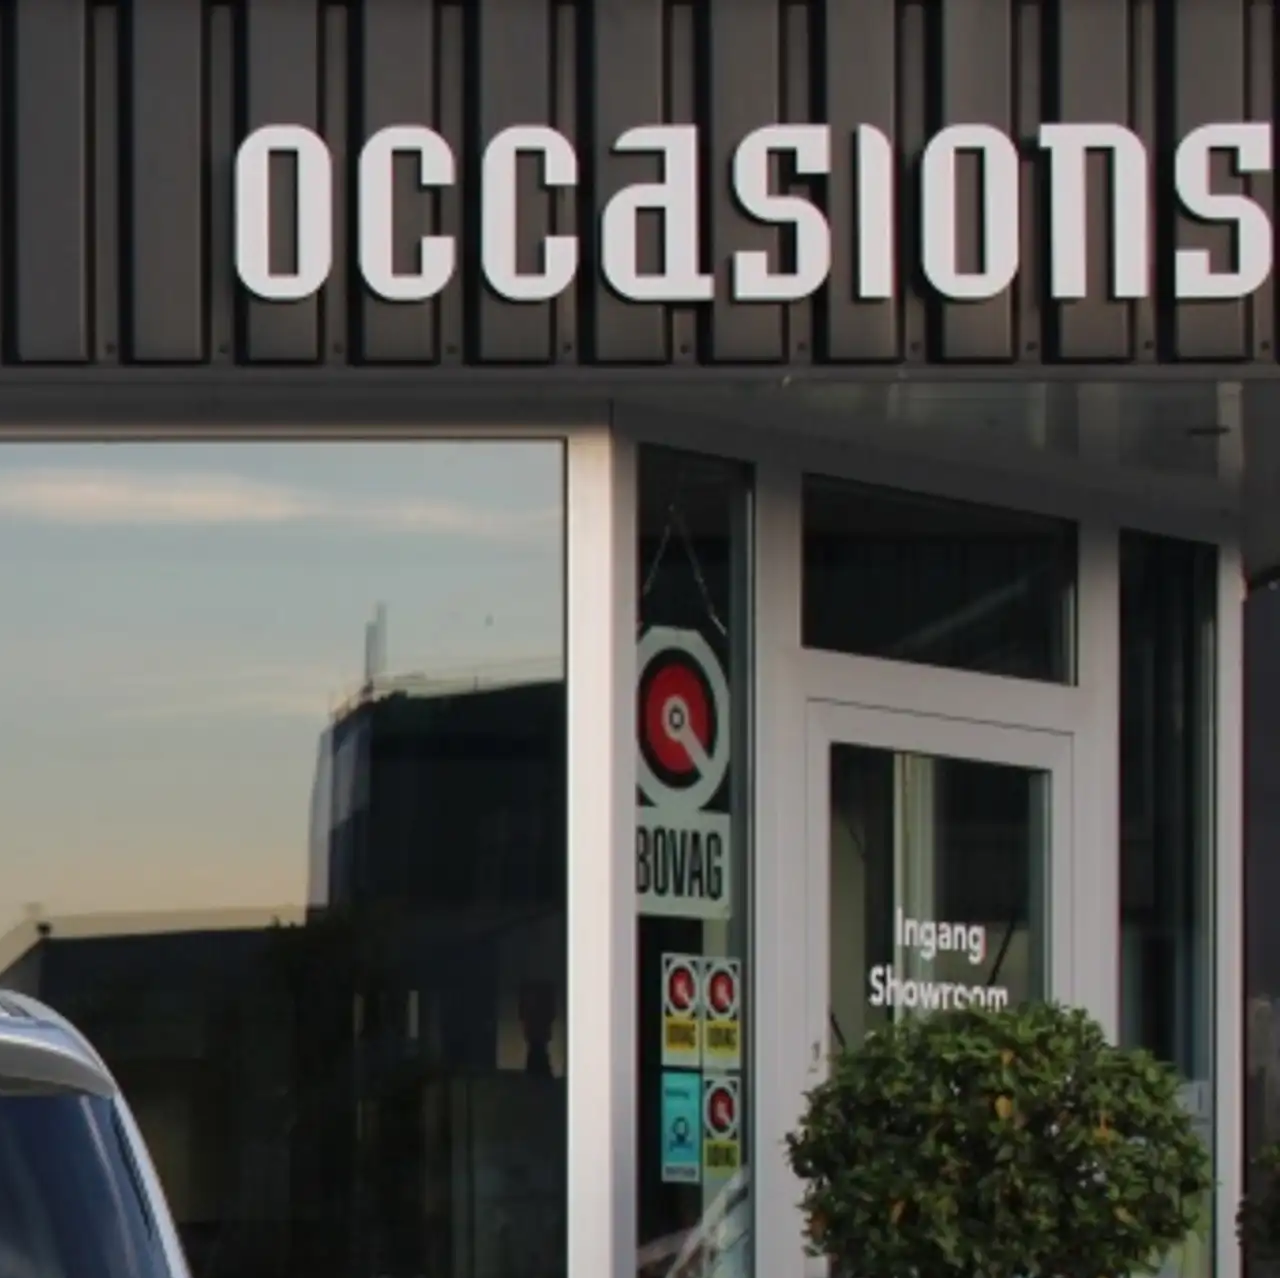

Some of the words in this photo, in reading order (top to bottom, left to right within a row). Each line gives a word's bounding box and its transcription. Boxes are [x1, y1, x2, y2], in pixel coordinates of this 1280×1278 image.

[234, 123, 1273, 302] occasions
[636, 824, 724, 901] BOVAG
[895, 906, 987, 966] Ingang
[868, 963, 1009, 1014] Showroom
